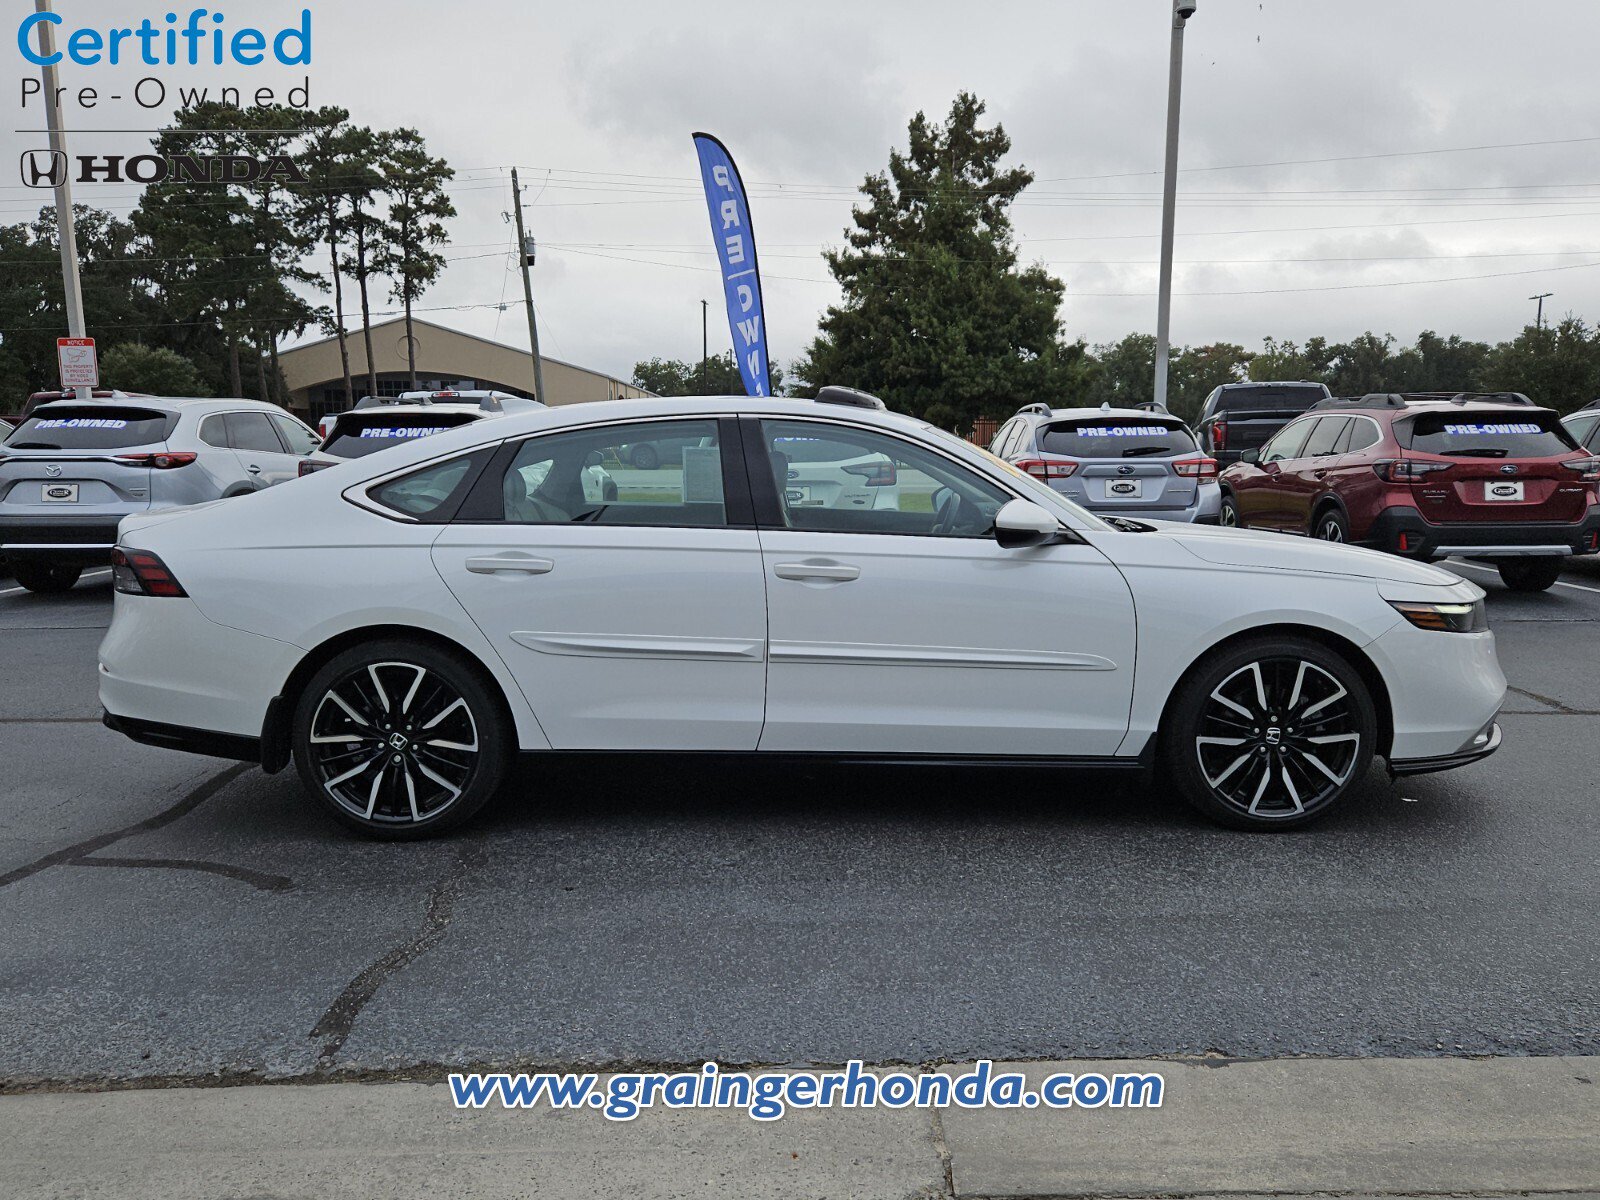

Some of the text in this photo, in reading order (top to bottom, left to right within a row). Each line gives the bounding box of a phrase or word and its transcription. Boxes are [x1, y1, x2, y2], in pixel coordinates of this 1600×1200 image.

[34, 418, 127, 429] PRE-OWNED
[1443, 423, 1542, 435] PRE-OWNED
[1076, 426, 1169, 437] PRE-OWNED
